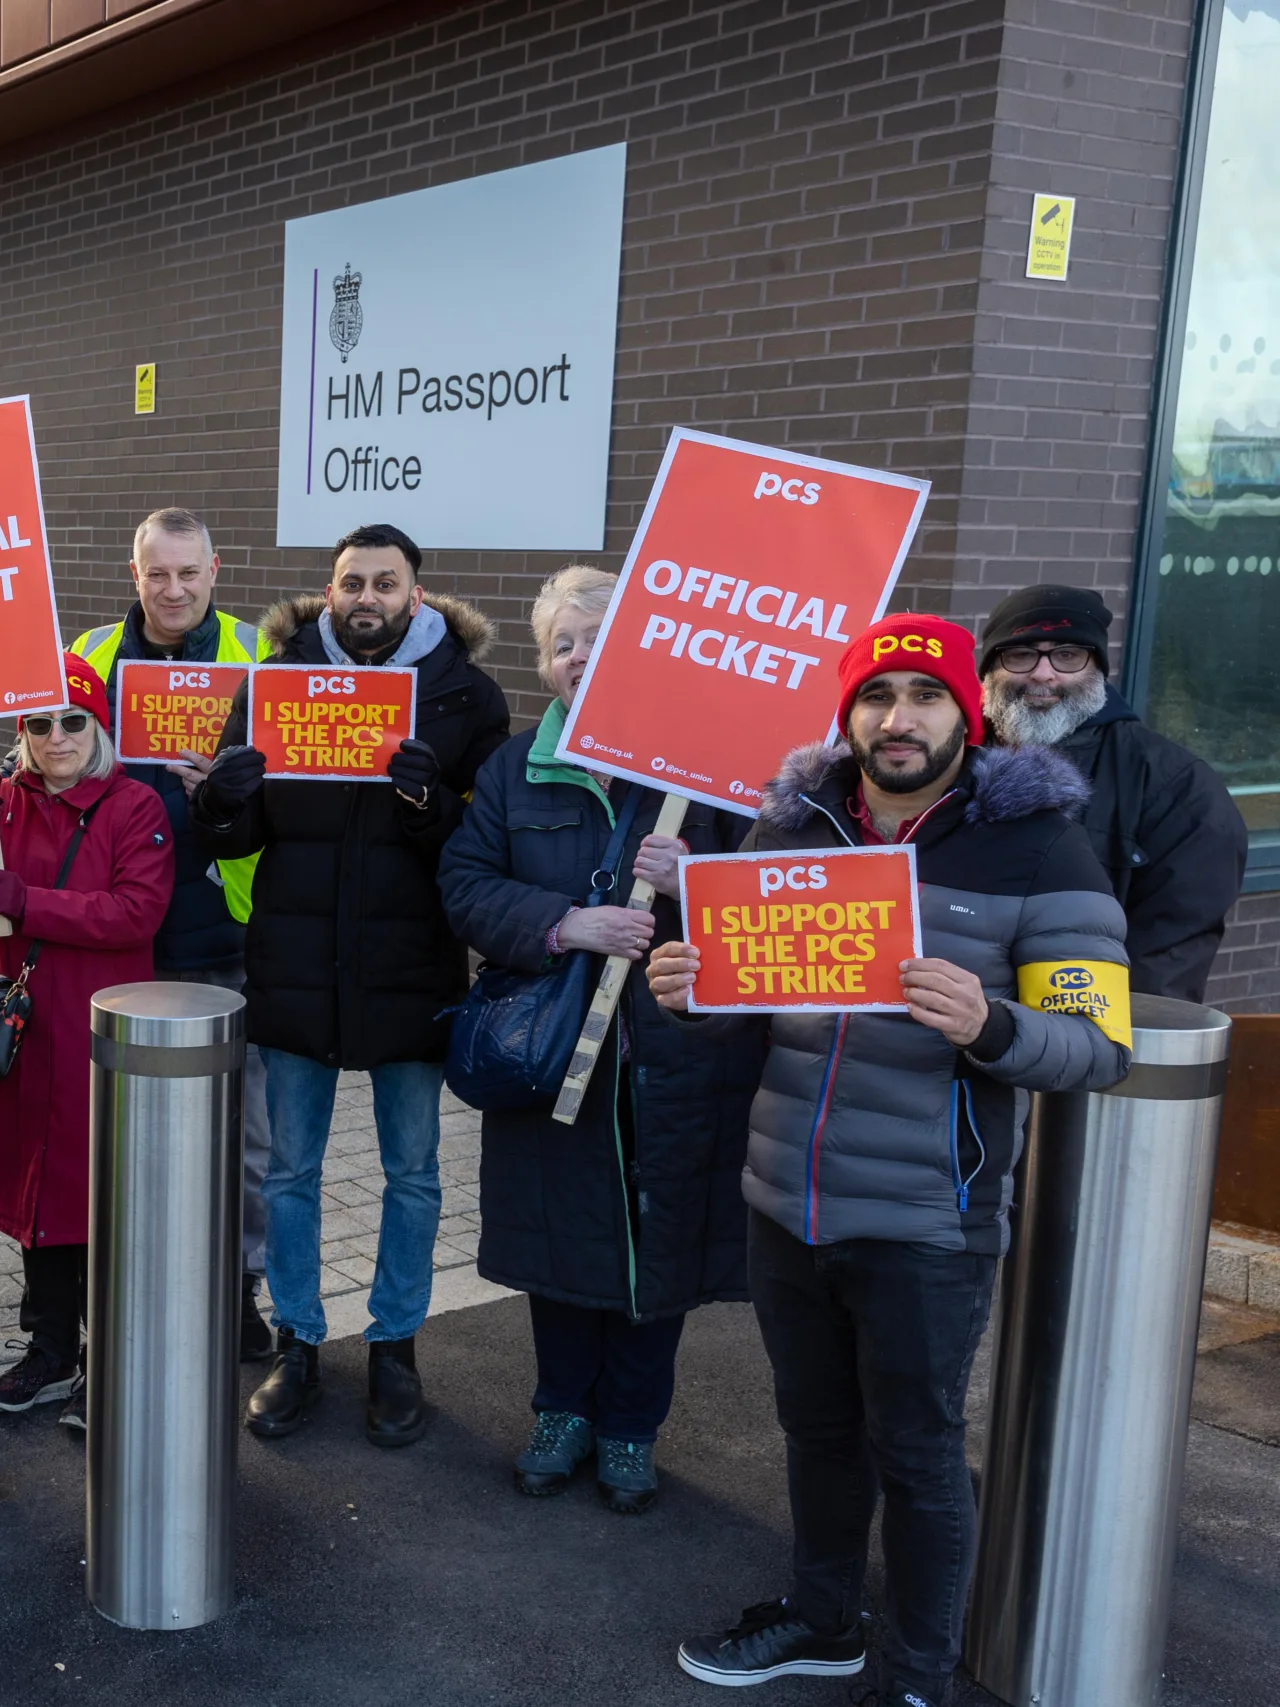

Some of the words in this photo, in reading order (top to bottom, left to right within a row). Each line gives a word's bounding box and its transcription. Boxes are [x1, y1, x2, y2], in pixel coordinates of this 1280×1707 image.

[1035, 236, 1065, 250] Warning
[1037, 250, 1054, 258] CCTV
[327, 370, 383, 420] HM
[397, 353, 571, 421] Passport
[324, 446, 422, 493] Office
[754, 472, 822, 505] pcs
[643, 560, 850, 644] OFFICIAL
[639, 614, 820, 690] PICKET
[872, 634, 943, 662] pcs
[68, 676, 92, 695] cs
[169, 672, 210, 690] pcs
[308, 676, 356, 698] pcs
[16, 690, 54, 702] @PcsUnion
[131, 694, 138, 712] I
[142, 694, 233, 715] SUPPOR
[142, 714, 186, 733] THE
[264, 702, 271, 722] I
[277, 702, 400, 724] SUPPORT
[277, 724, 330, 744] THE
[336, 724, 384, 746] PCS
[285, 746, 374, 768] STRIKE
[594, 742, 634, 760] pcs.org.uk
[665, 764, 713, 784] @pcs_union
[758, 864, 828, 898] pcs
[702, 907, 712, 934] I
[721, 900, 896, 934] SUPPORT
[721, 935, 797, 964] THE
[805, 933, 876, 962] PCS
[736, 964, 866, 994] STRIKE
[1054, 972, 1091, 989] pcs
[1040, 992, 1110, 1008] OFFICIAL
